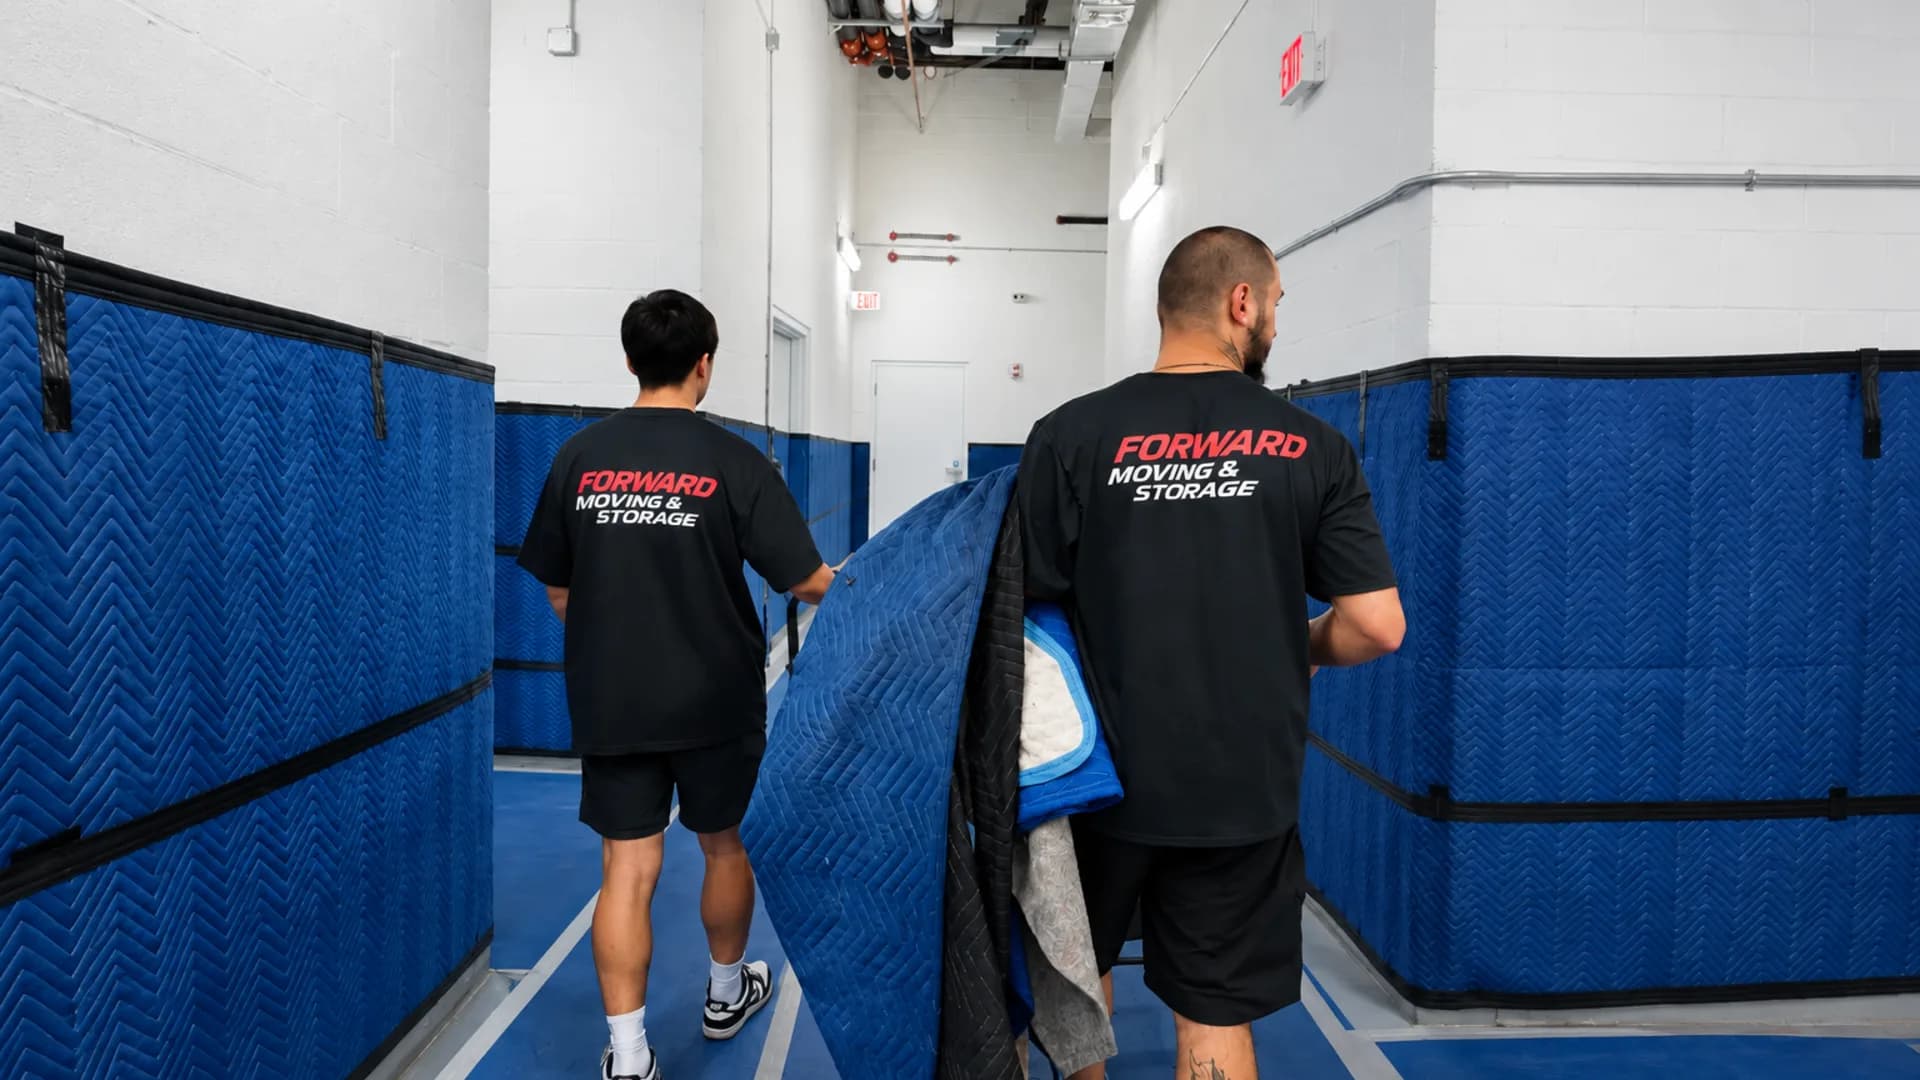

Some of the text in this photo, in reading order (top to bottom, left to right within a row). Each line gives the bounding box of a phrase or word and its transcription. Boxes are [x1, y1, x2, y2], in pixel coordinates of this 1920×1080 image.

[1281, 33, 1302, 98] EXIT
[857, 292, 878, 309] EXIT
[1114, 430, 1307, 463] FORWARD
[577, 470, 718, 498] FORWARD
[1108, 460, 1240, 485] MOVING &
[576, 493, 682, 511] MOVING &
[1133, 480, 1259, 502] STORAGE
[596, 509, 699, 527] STORAGE
